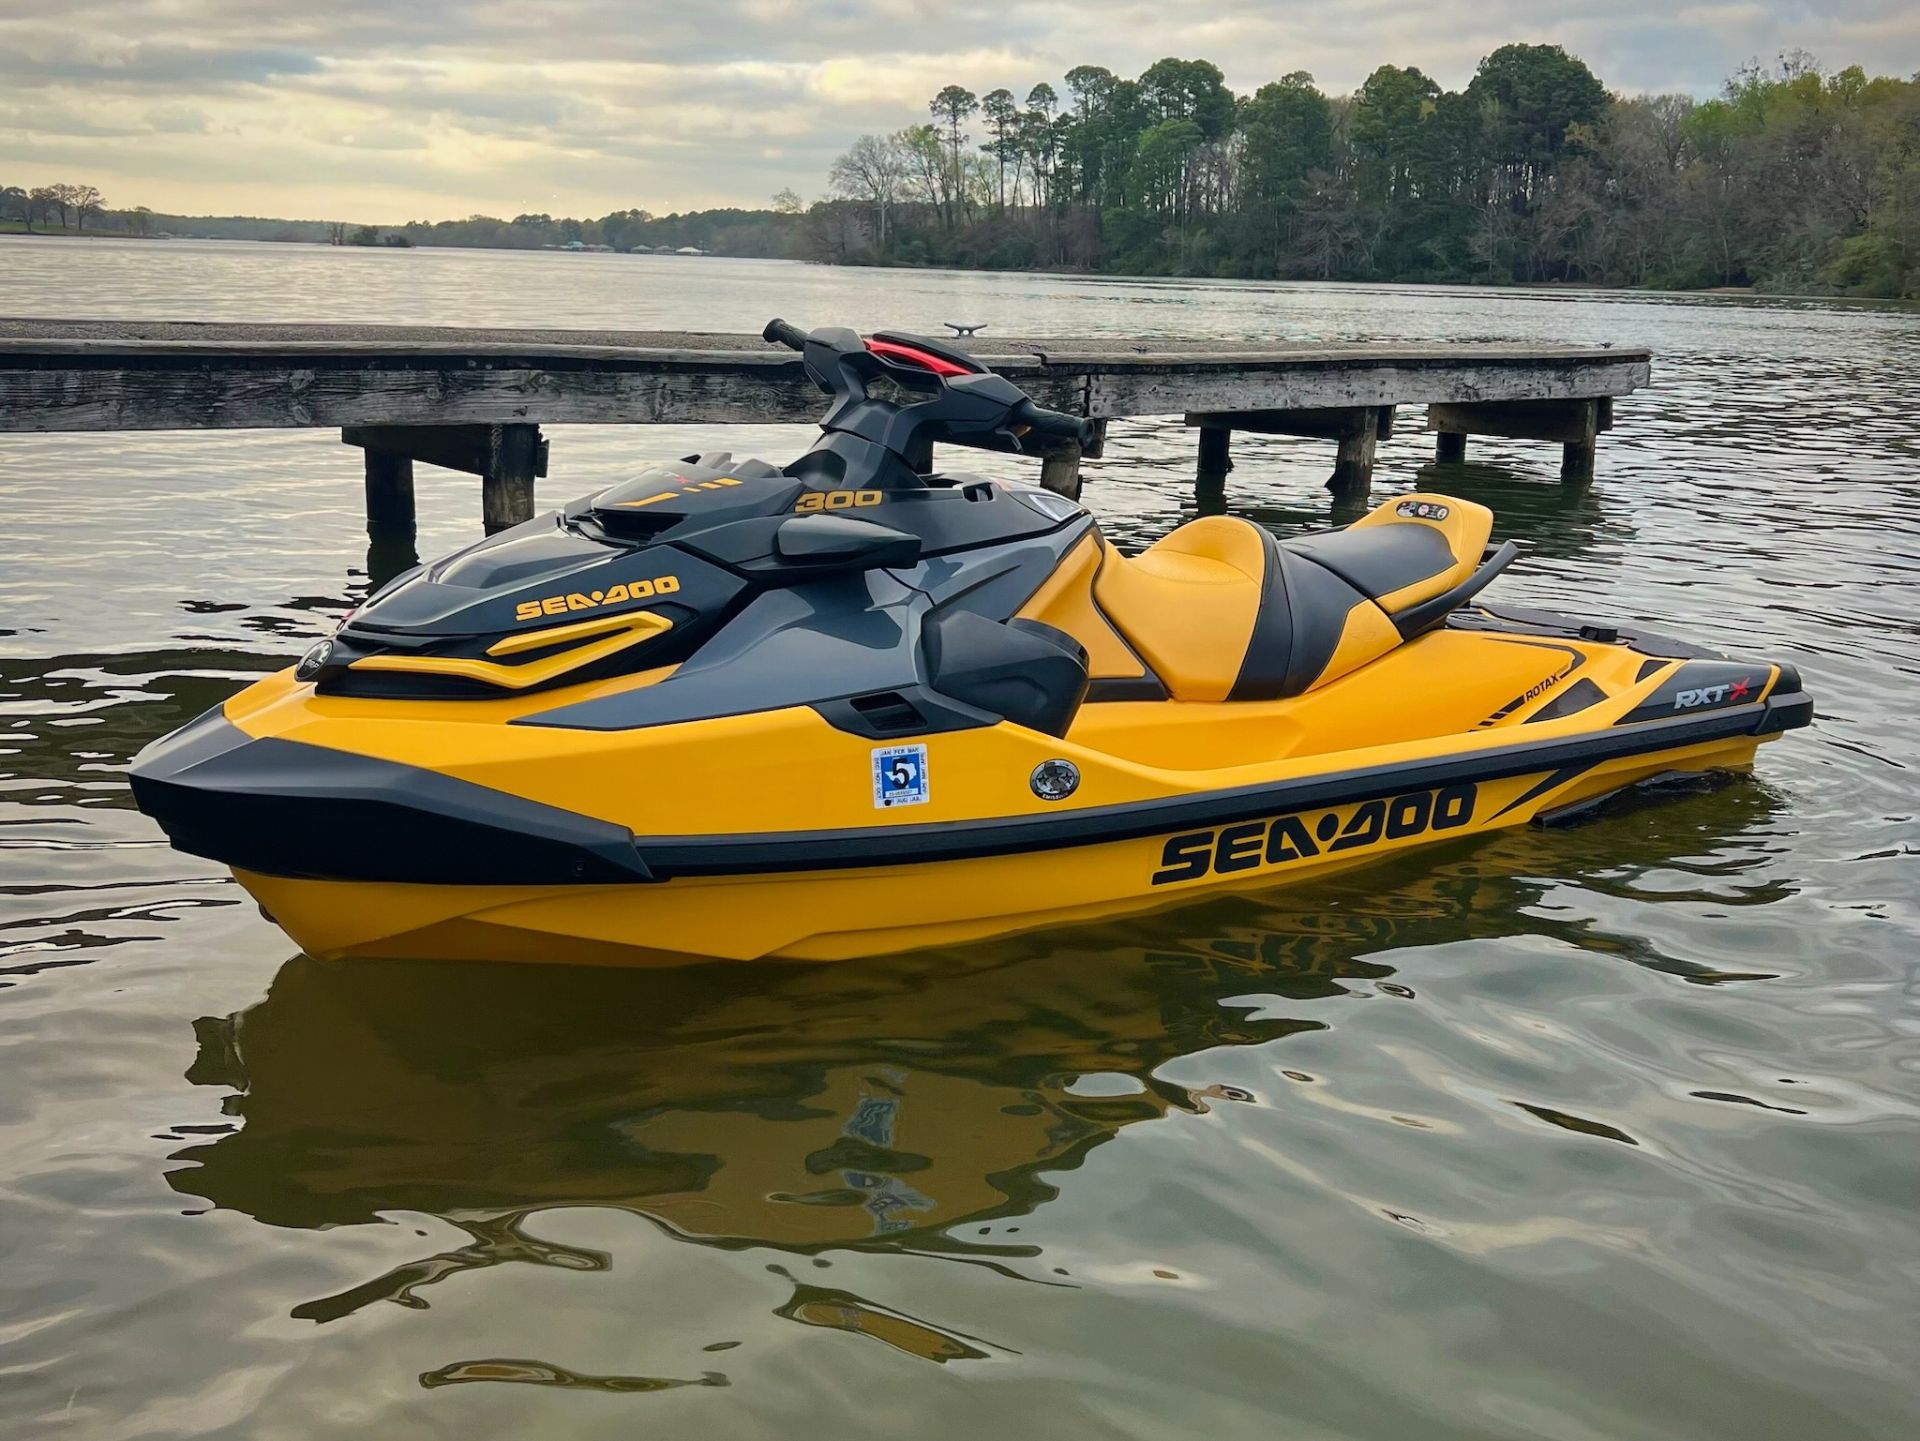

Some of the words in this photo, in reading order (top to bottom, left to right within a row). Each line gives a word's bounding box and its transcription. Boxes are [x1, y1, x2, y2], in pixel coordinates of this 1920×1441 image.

[795, 489, 883, 513] 300
[1525, 673, 1559, 701] ROTAX
[1674, 684, 1730, 709] RXT
[892, 757, 909, 789] 5
